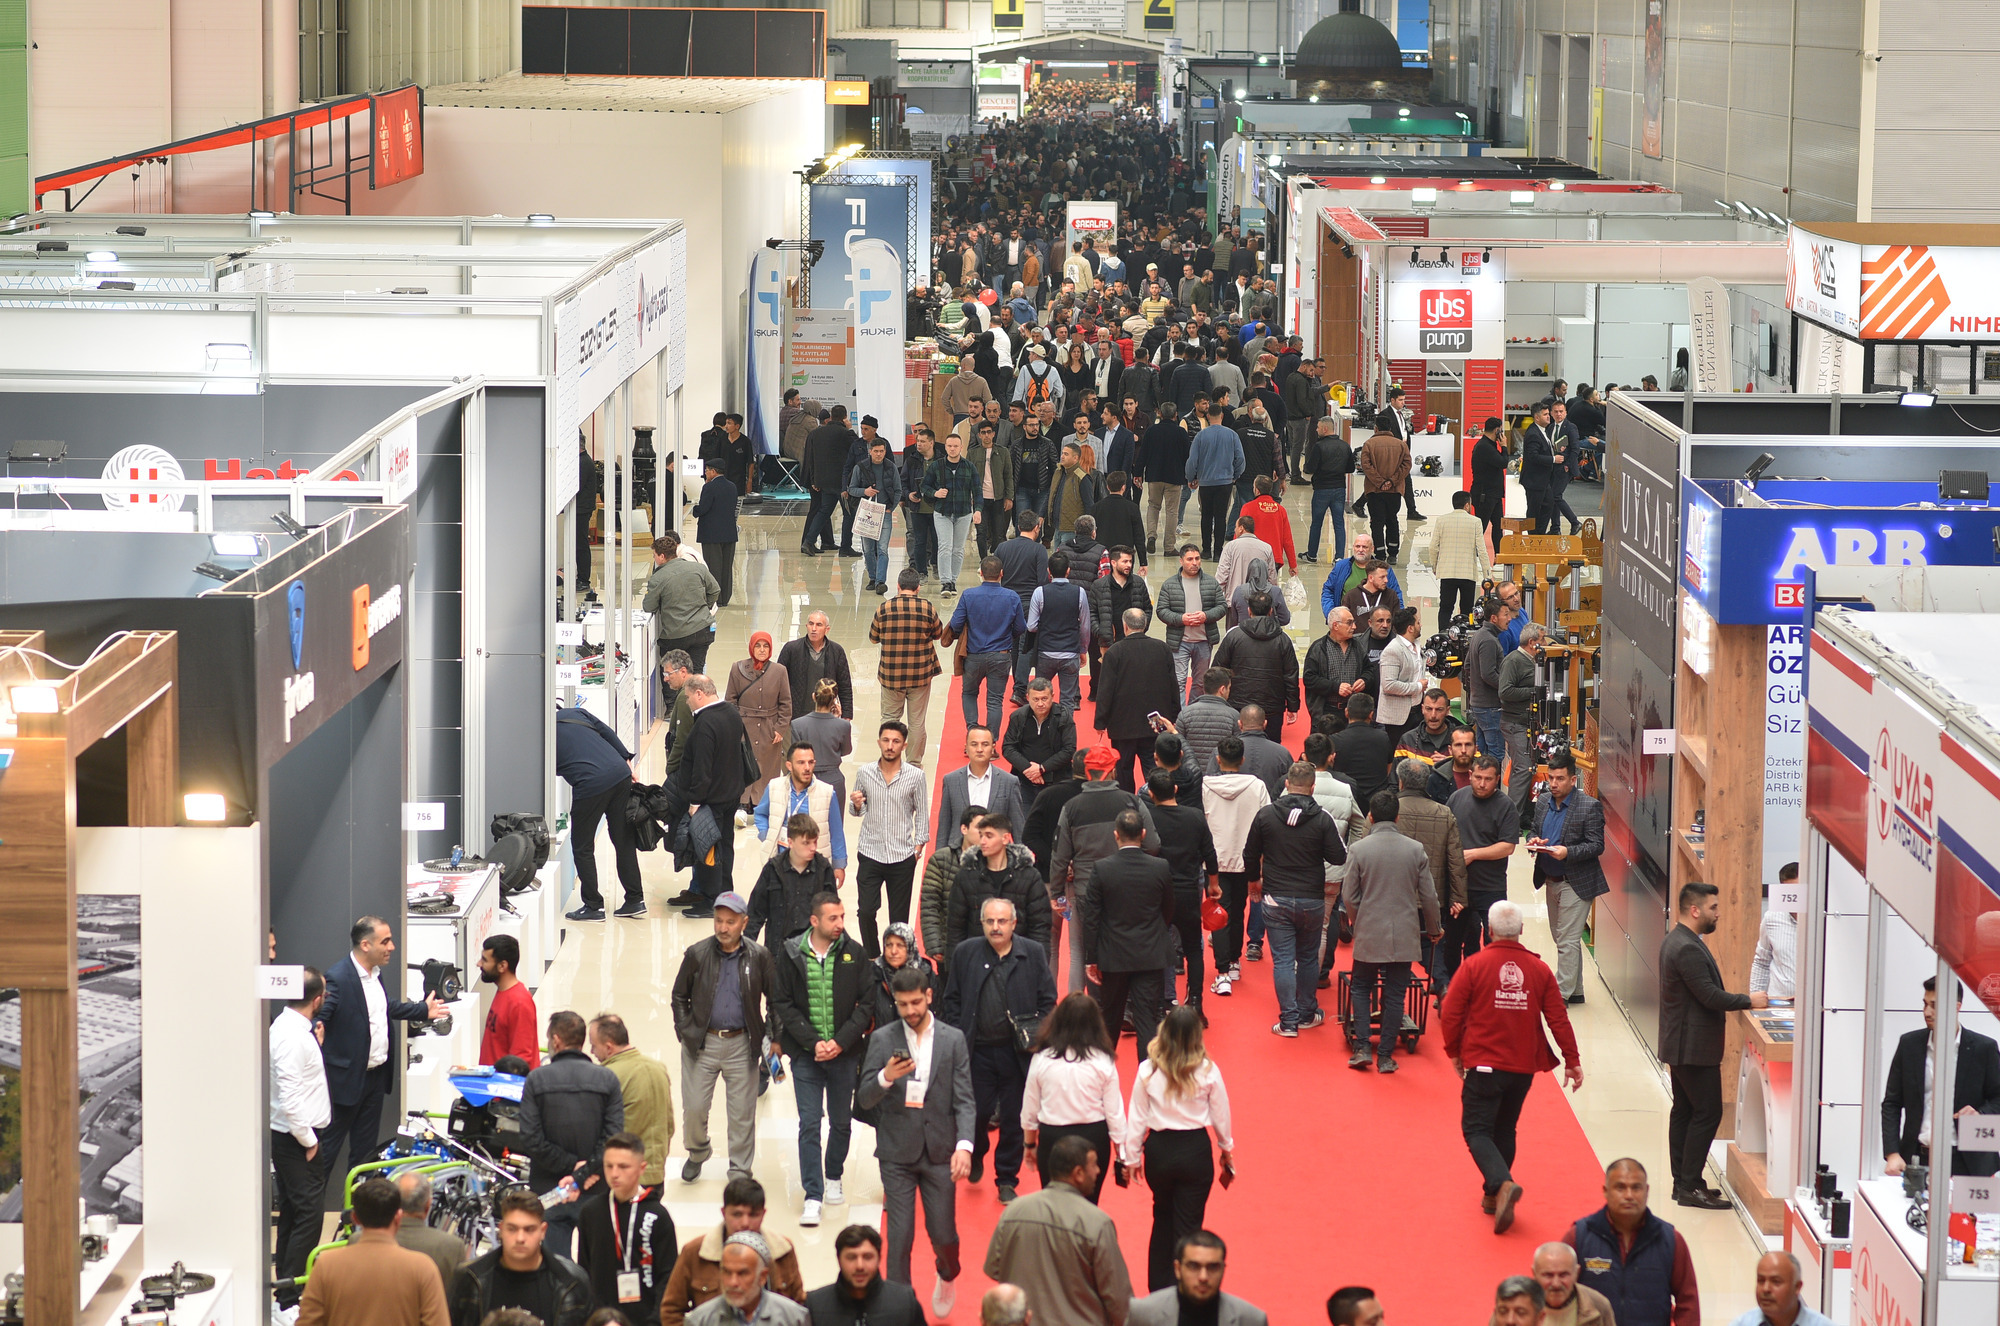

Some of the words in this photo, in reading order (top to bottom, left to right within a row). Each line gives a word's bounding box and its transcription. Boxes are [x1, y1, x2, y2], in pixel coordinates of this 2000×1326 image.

[1463, 254, 1479, 266] ybs
[1426, 291, 1466, 326] ybs
[1426, 332, 1466, 350] pump
[1620, 472, 1674, 568] UYSAL
[1774, 527, 1926, 579] ARB
[1619, 560, 1672, 628] HYDRAULIC
[1653, 737, 1668, 745] 751
[1765, 784, 1790, 792] ARB
[1893, 746, 1934, 830] UYAR
[416, 813, 432, 821] 756
[1781, 894, 1798, 903] 752
[270, 976, 289, 986] 755
[1974, 1128, 1995, 1138] 754
[1969, 1189, 1990, 1199] 753
